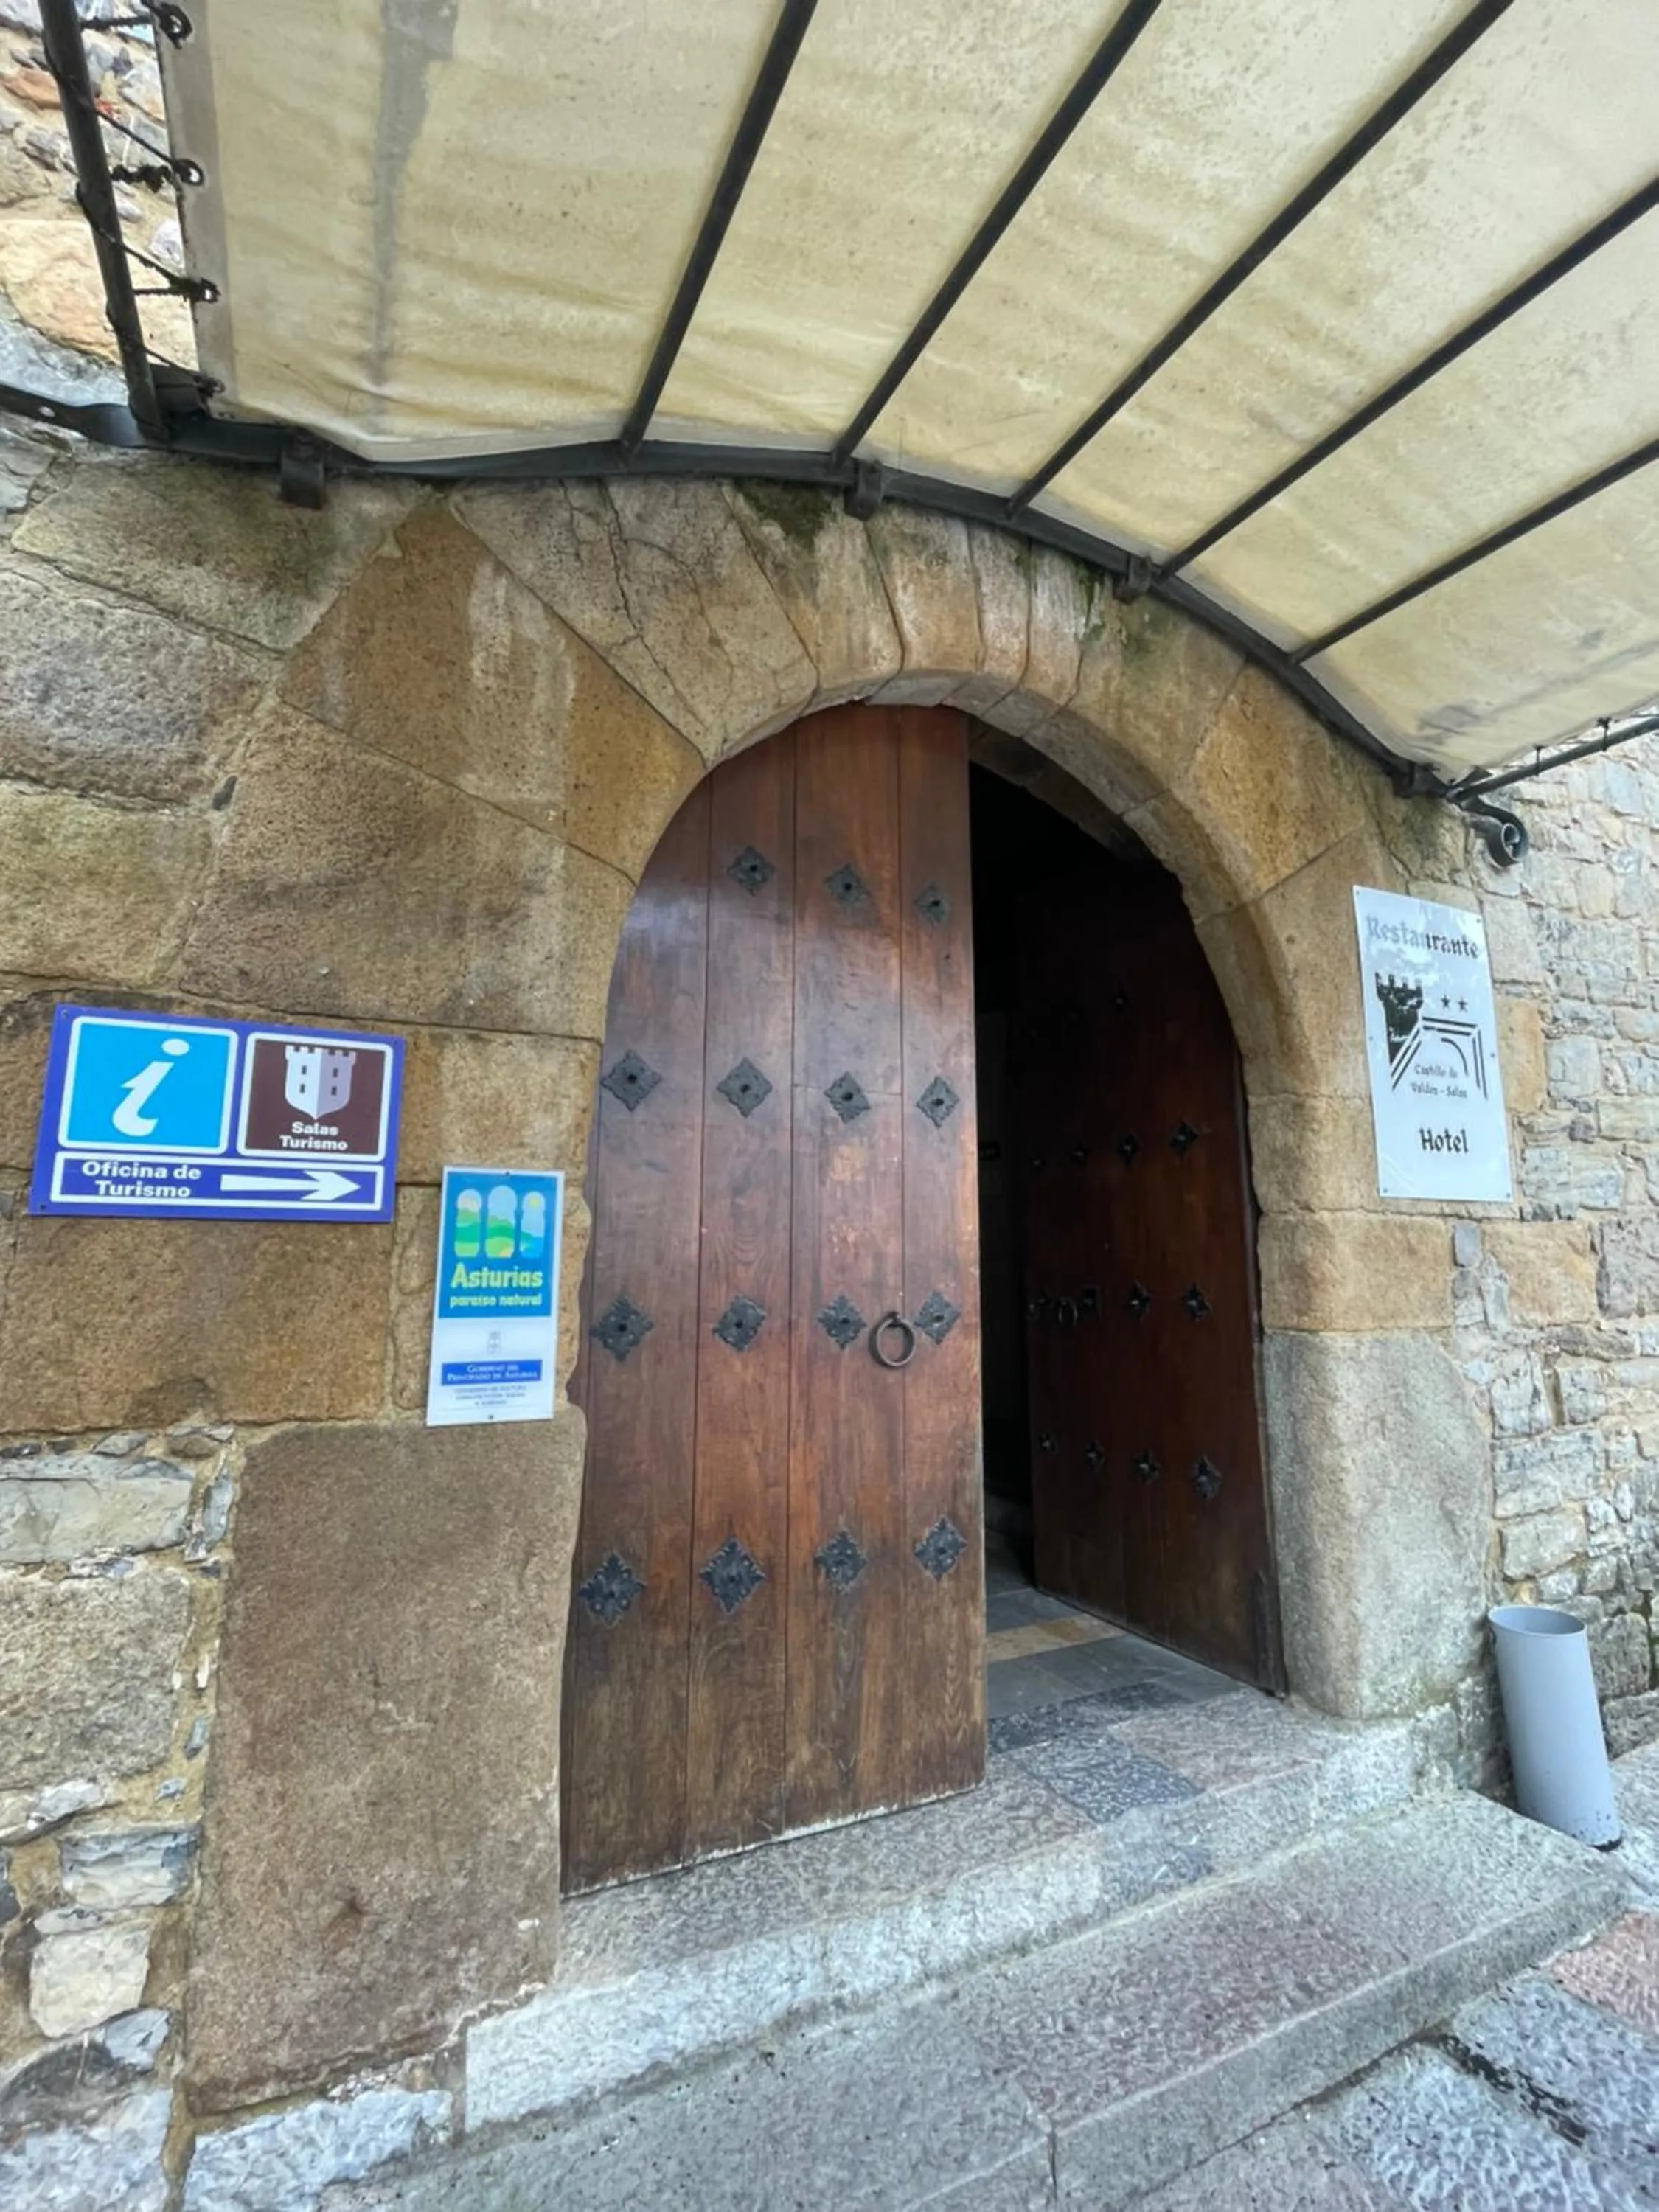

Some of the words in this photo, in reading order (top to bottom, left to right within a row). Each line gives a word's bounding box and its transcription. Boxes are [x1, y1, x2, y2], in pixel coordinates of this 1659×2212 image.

[1366, 915, 1478, 959] Restaurante
[291, 1121, 339, 1136] Salas
[279, 1135, 348, 1150] Turismo
[1419, 1128, 1468, 1153] Hotel
[82, 1161, 168, 1178] Oficina
[173, 1164, 201, 1180] de
[94, 1180, 192, 1197] Turismo
[451, 1262, 543, 1289] Asturias
